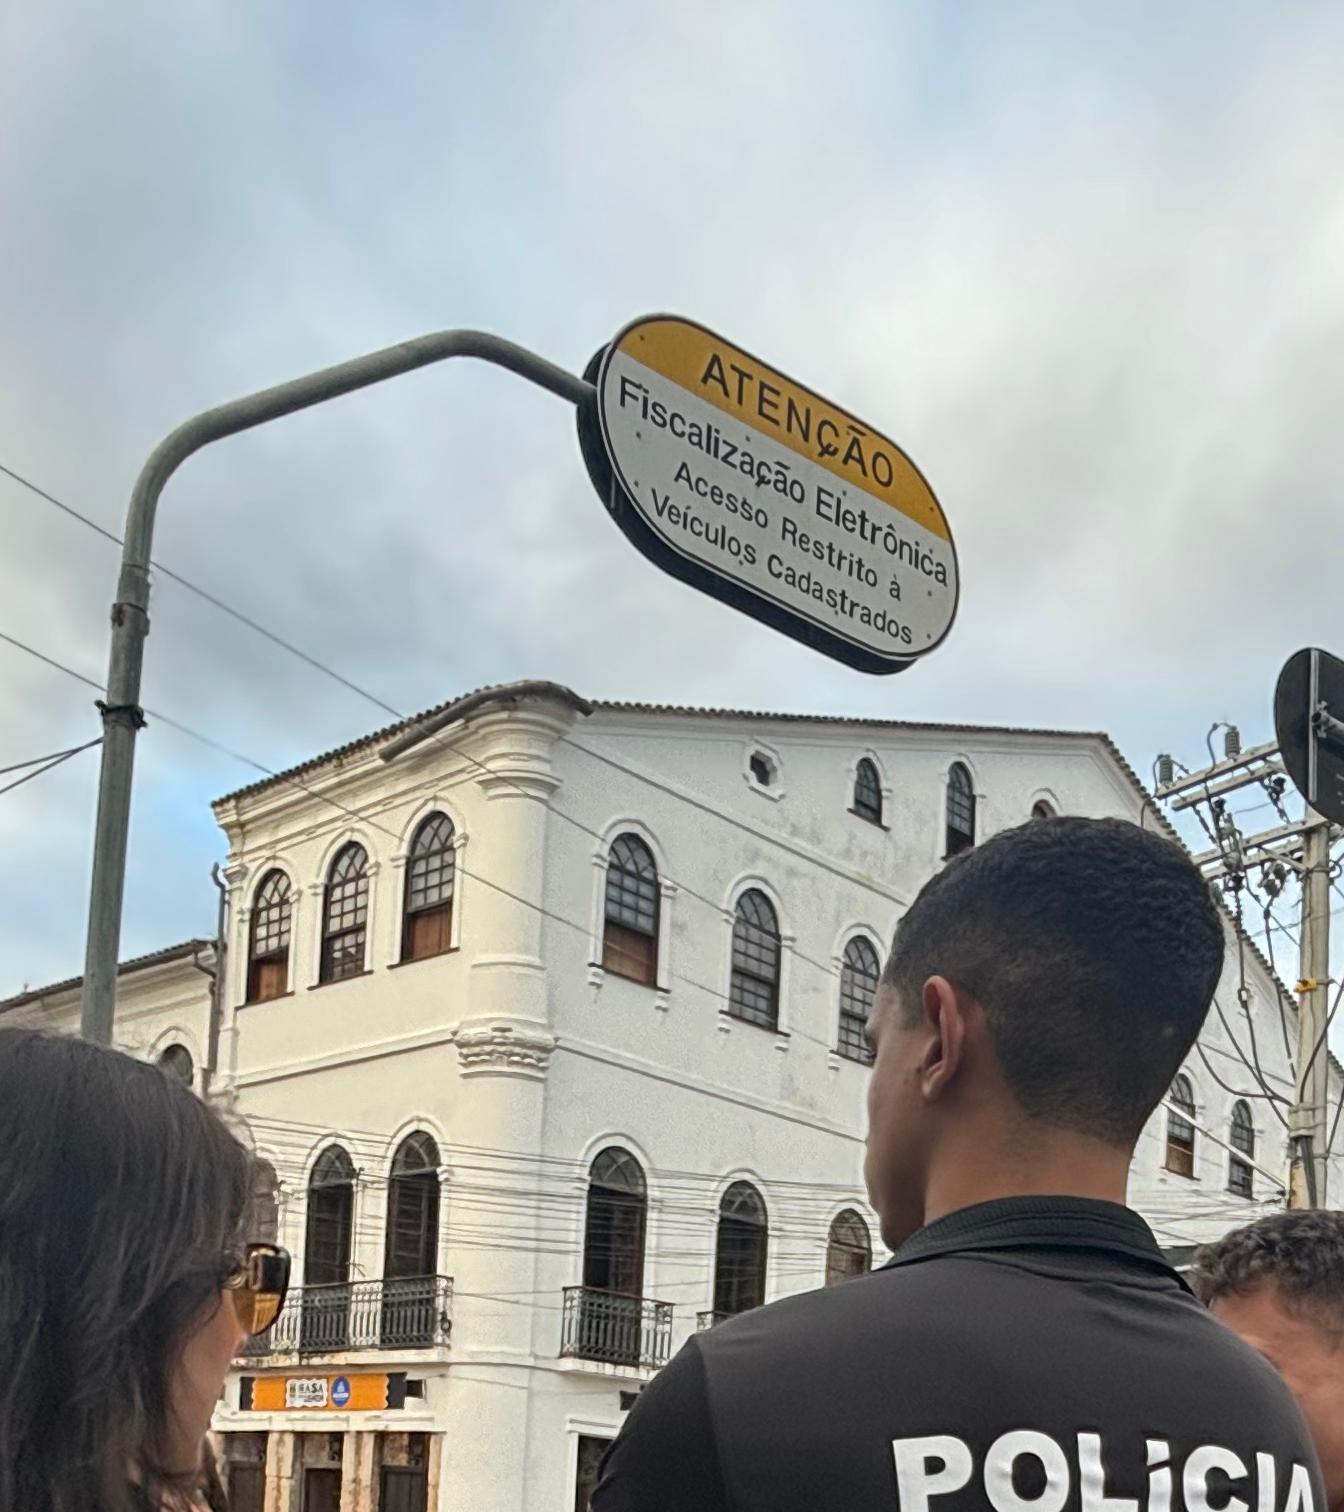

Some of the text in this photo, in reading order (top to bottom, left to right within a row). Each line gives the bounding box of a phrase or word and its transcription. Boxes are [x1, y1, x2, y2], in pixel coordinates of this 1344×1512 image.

[618, 375, 949, 588] Fiscalização Eletrônica
[701, 353, 895, 489] ATENÇÃO
[650, 486, 913, 645] Veículos Cadastrados
[674, 461, 902, 601] Acesso Restrito à
